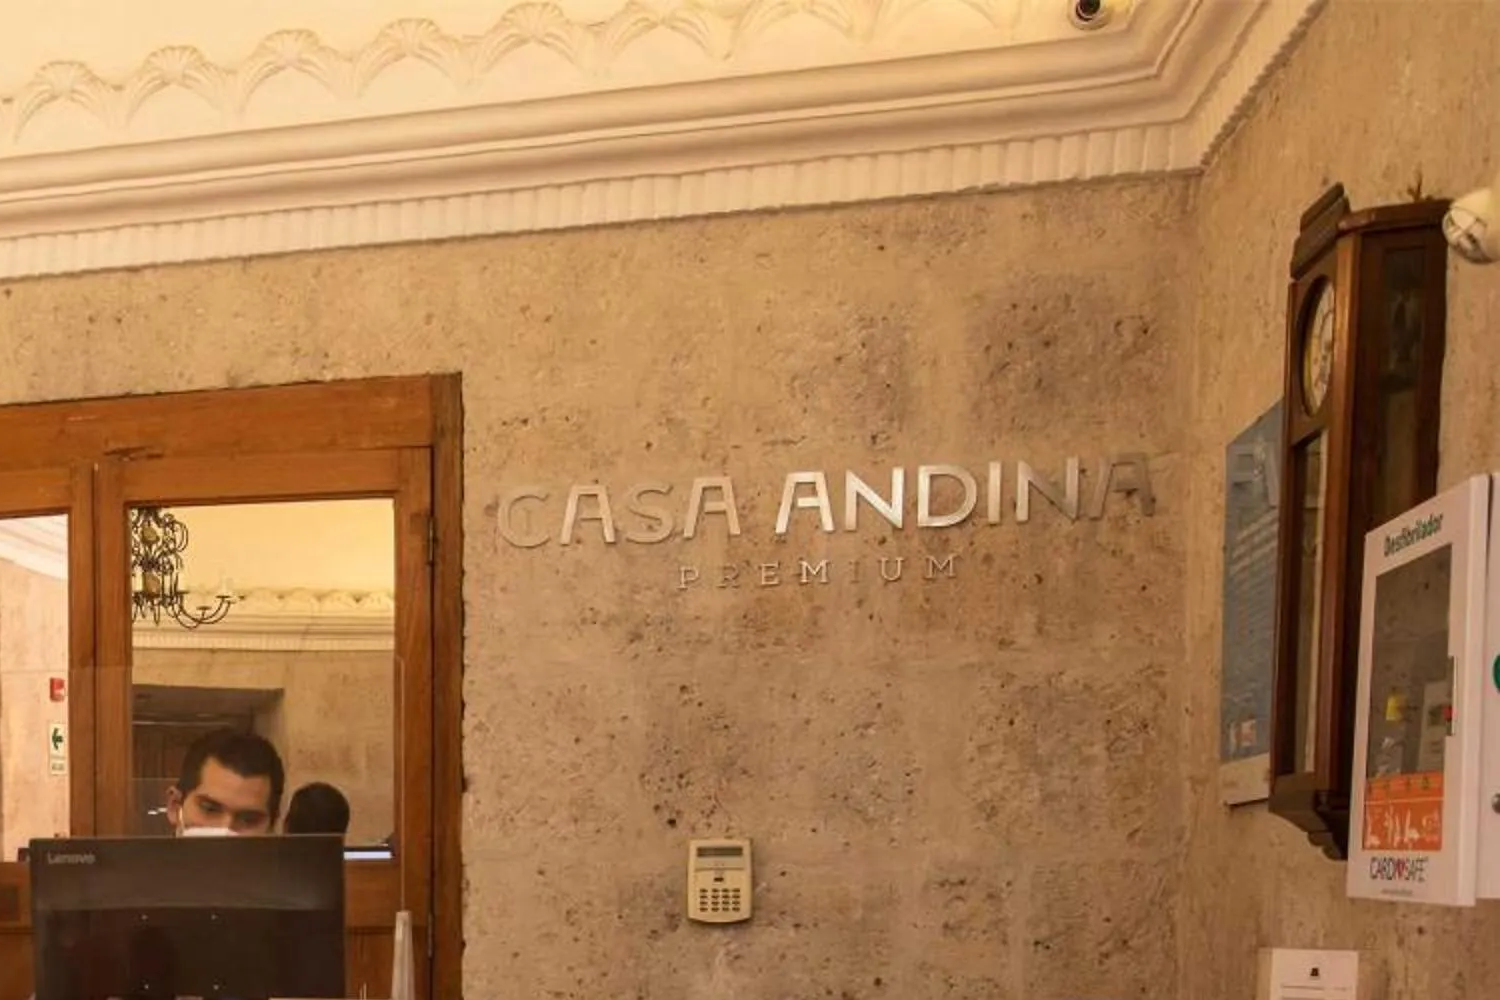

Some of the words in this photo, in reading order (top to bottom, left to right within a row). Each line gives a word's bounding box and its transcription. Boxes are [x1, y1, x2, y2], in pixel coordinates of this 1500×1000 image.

[498, 476, 741, 547] CASA
[774, 454, 1156, 536] ANDINA
[676, 553, 957, 589] PREMIUM
